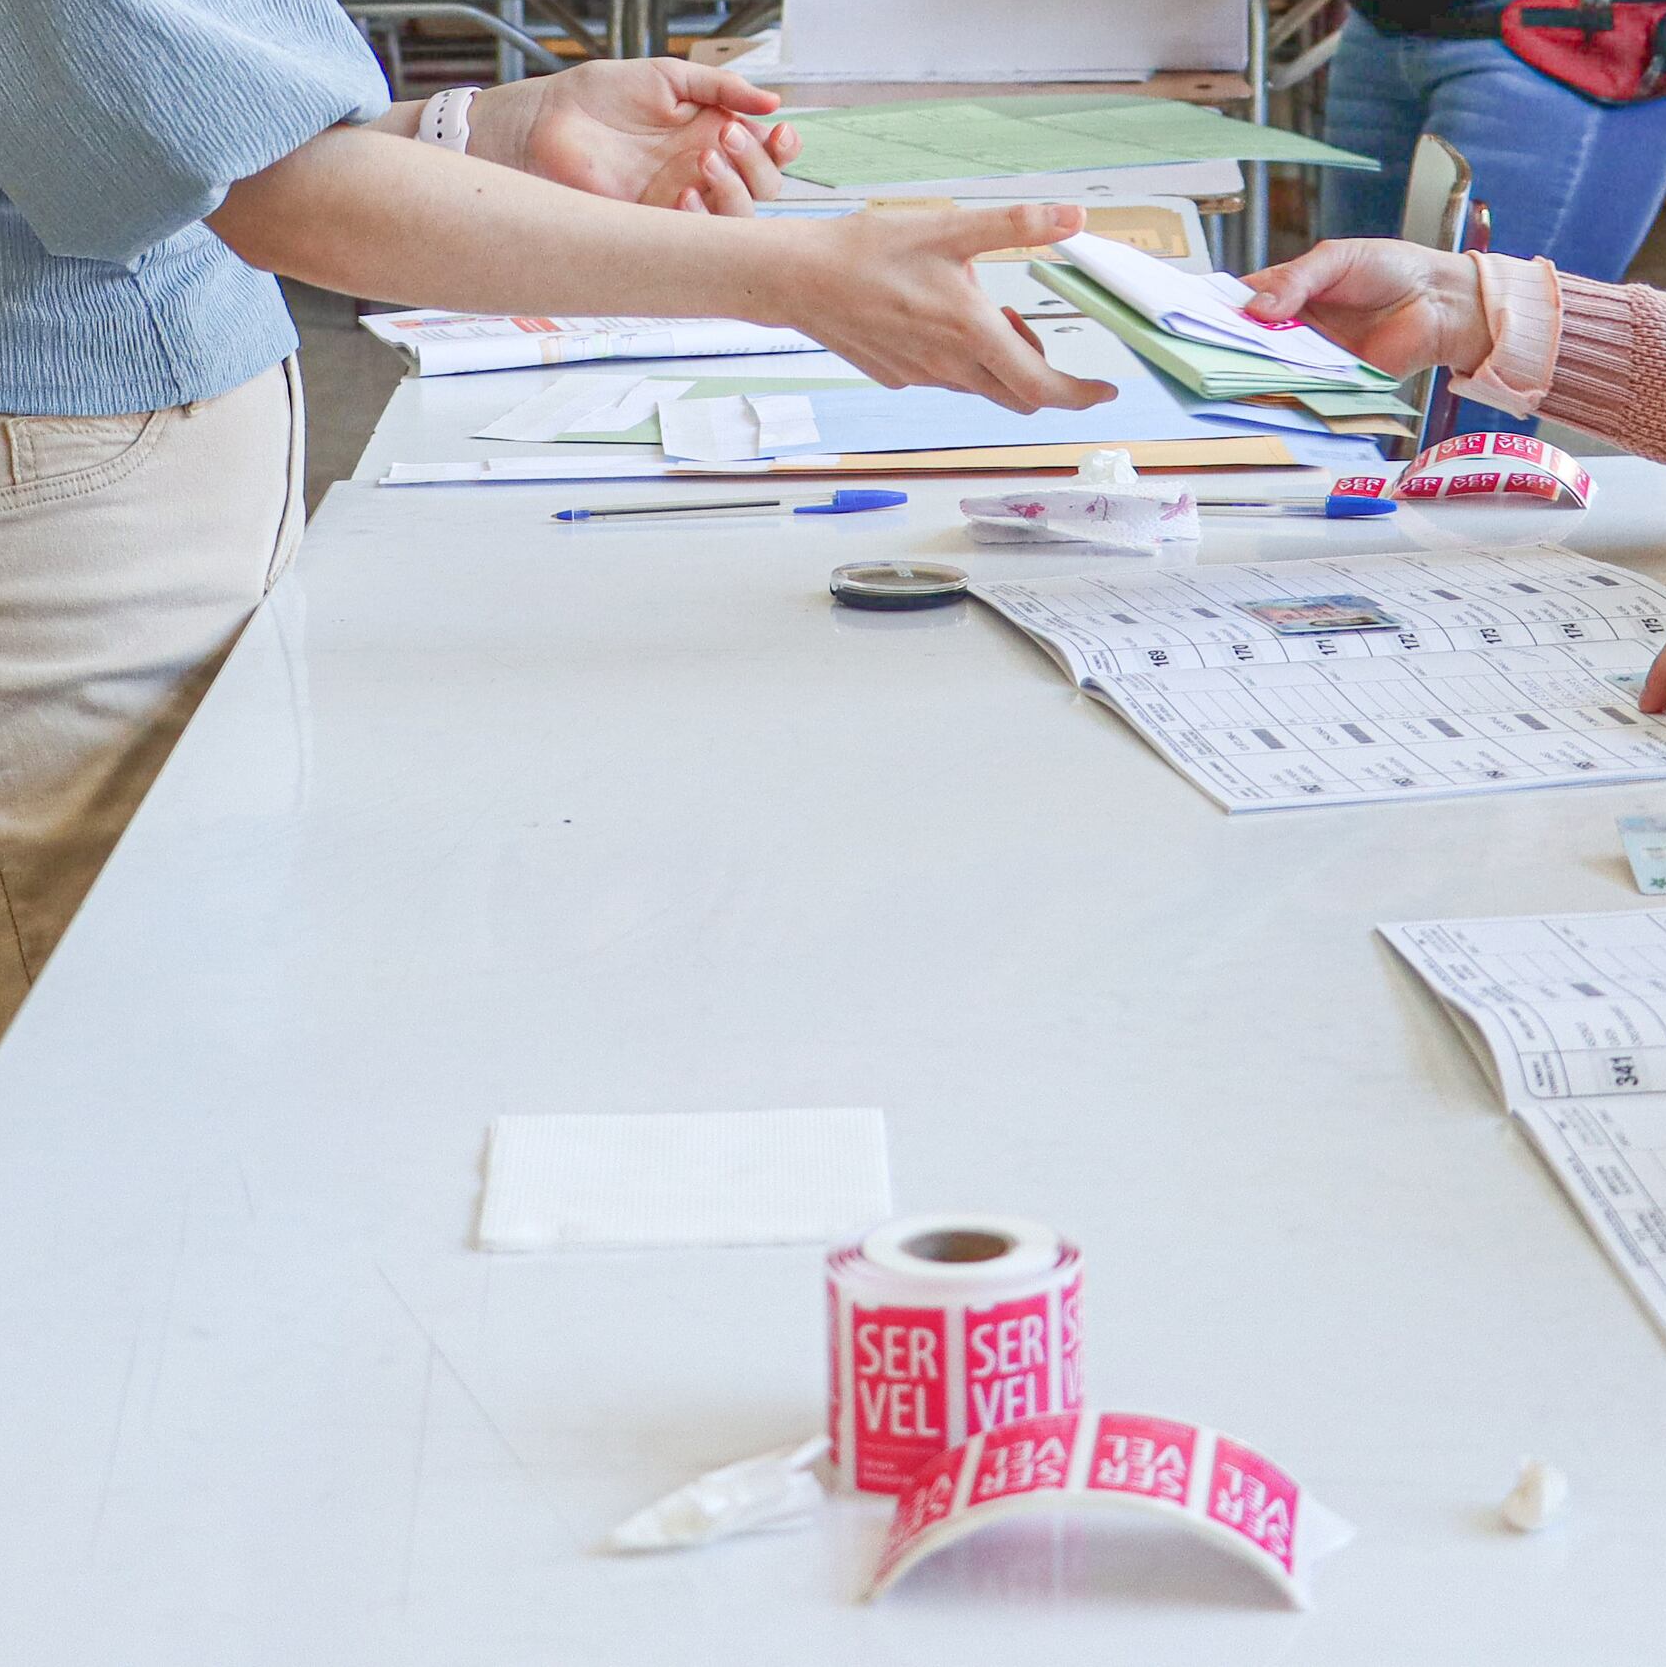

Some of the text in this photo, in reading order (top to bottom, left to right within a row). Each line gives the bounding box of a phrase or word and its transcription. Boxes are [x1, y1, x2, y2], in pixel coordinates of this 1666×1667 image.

[1441, 435, 1481, 448] SER
[1498, 435, 1539, 449] SER
[1498, 441, 1535, 455] VEL
[1339, 483, 1376, 492] VEL
[1340, 478, 1381, 486] SER
[1454, 474, 1495, 483] SER
[1511, 474, 1553, 486] SER
[1560, 623, 1584, 640] 174
[1640, 617, 1665, 635] 175
[1397, 632, 1421, 651] 172
[1479, 628, 1503, 645] 173
[1231, 643, 1255, 662] 170
[1315, 638, 1338, 656] 171
[1147, 649, 1170, 667] 169
[1609, 1055, 1639, 1086] 341
[856, 1323, 940, 1380] SER
[970, 1314, 1046, 1379] SER
[859, 1379, 942, 1438] VEL
[1102, 1434, 1187, 1471] VEL
[1096, 1458, 1184, 1497] SER
[1220, 1462, 1291, 1533] VEL
[1215, 1488, 1288, 1555] SER
